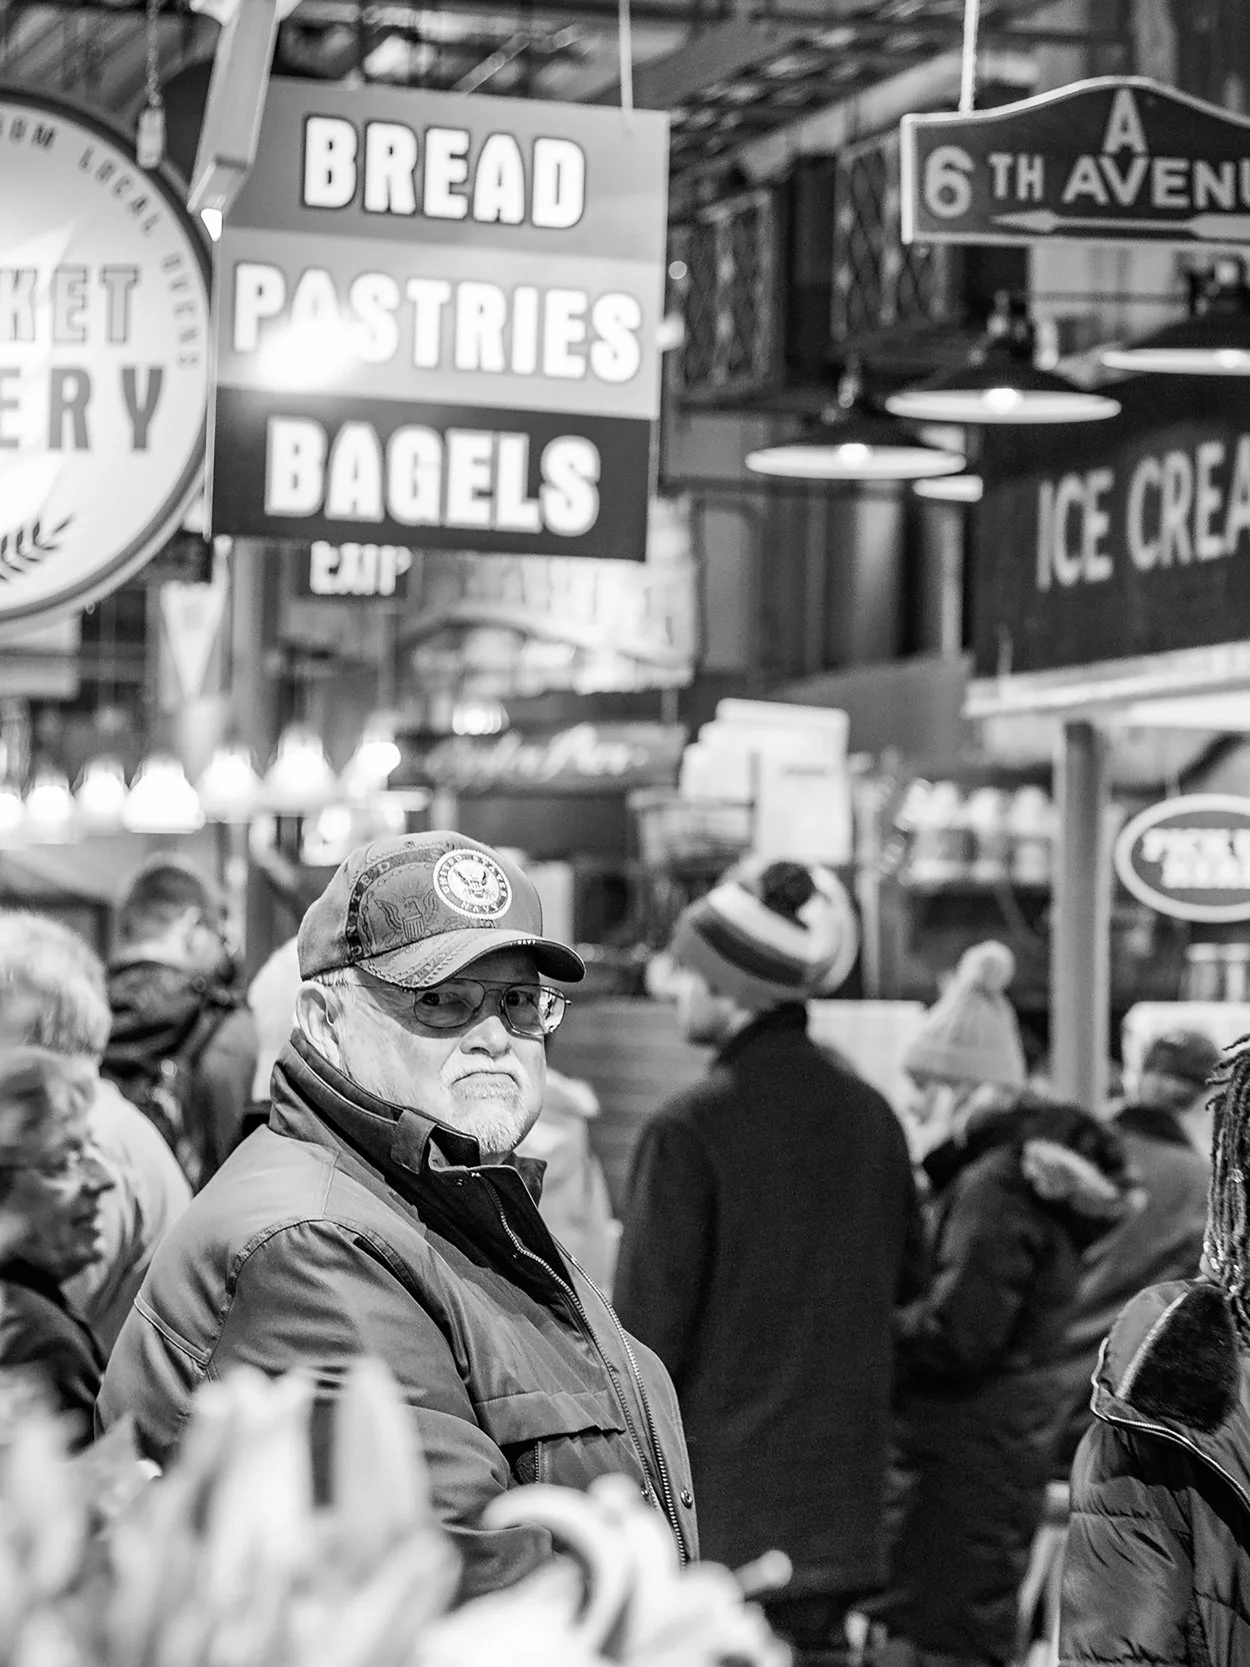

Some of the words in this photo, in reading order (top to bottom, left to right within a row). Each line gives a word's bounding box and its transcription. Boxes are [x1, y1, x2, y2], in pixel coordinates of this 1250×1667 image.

[304, 116, 586, 229] BREAD
[1104, 88, 1148, 154] A
[233, 263, 642, 384] PASTRIES
[264, 416, 601, 536] BAGELS
[1036, 468, 1114, 591] ICE
[461, 900, 499, 914] NAVY
